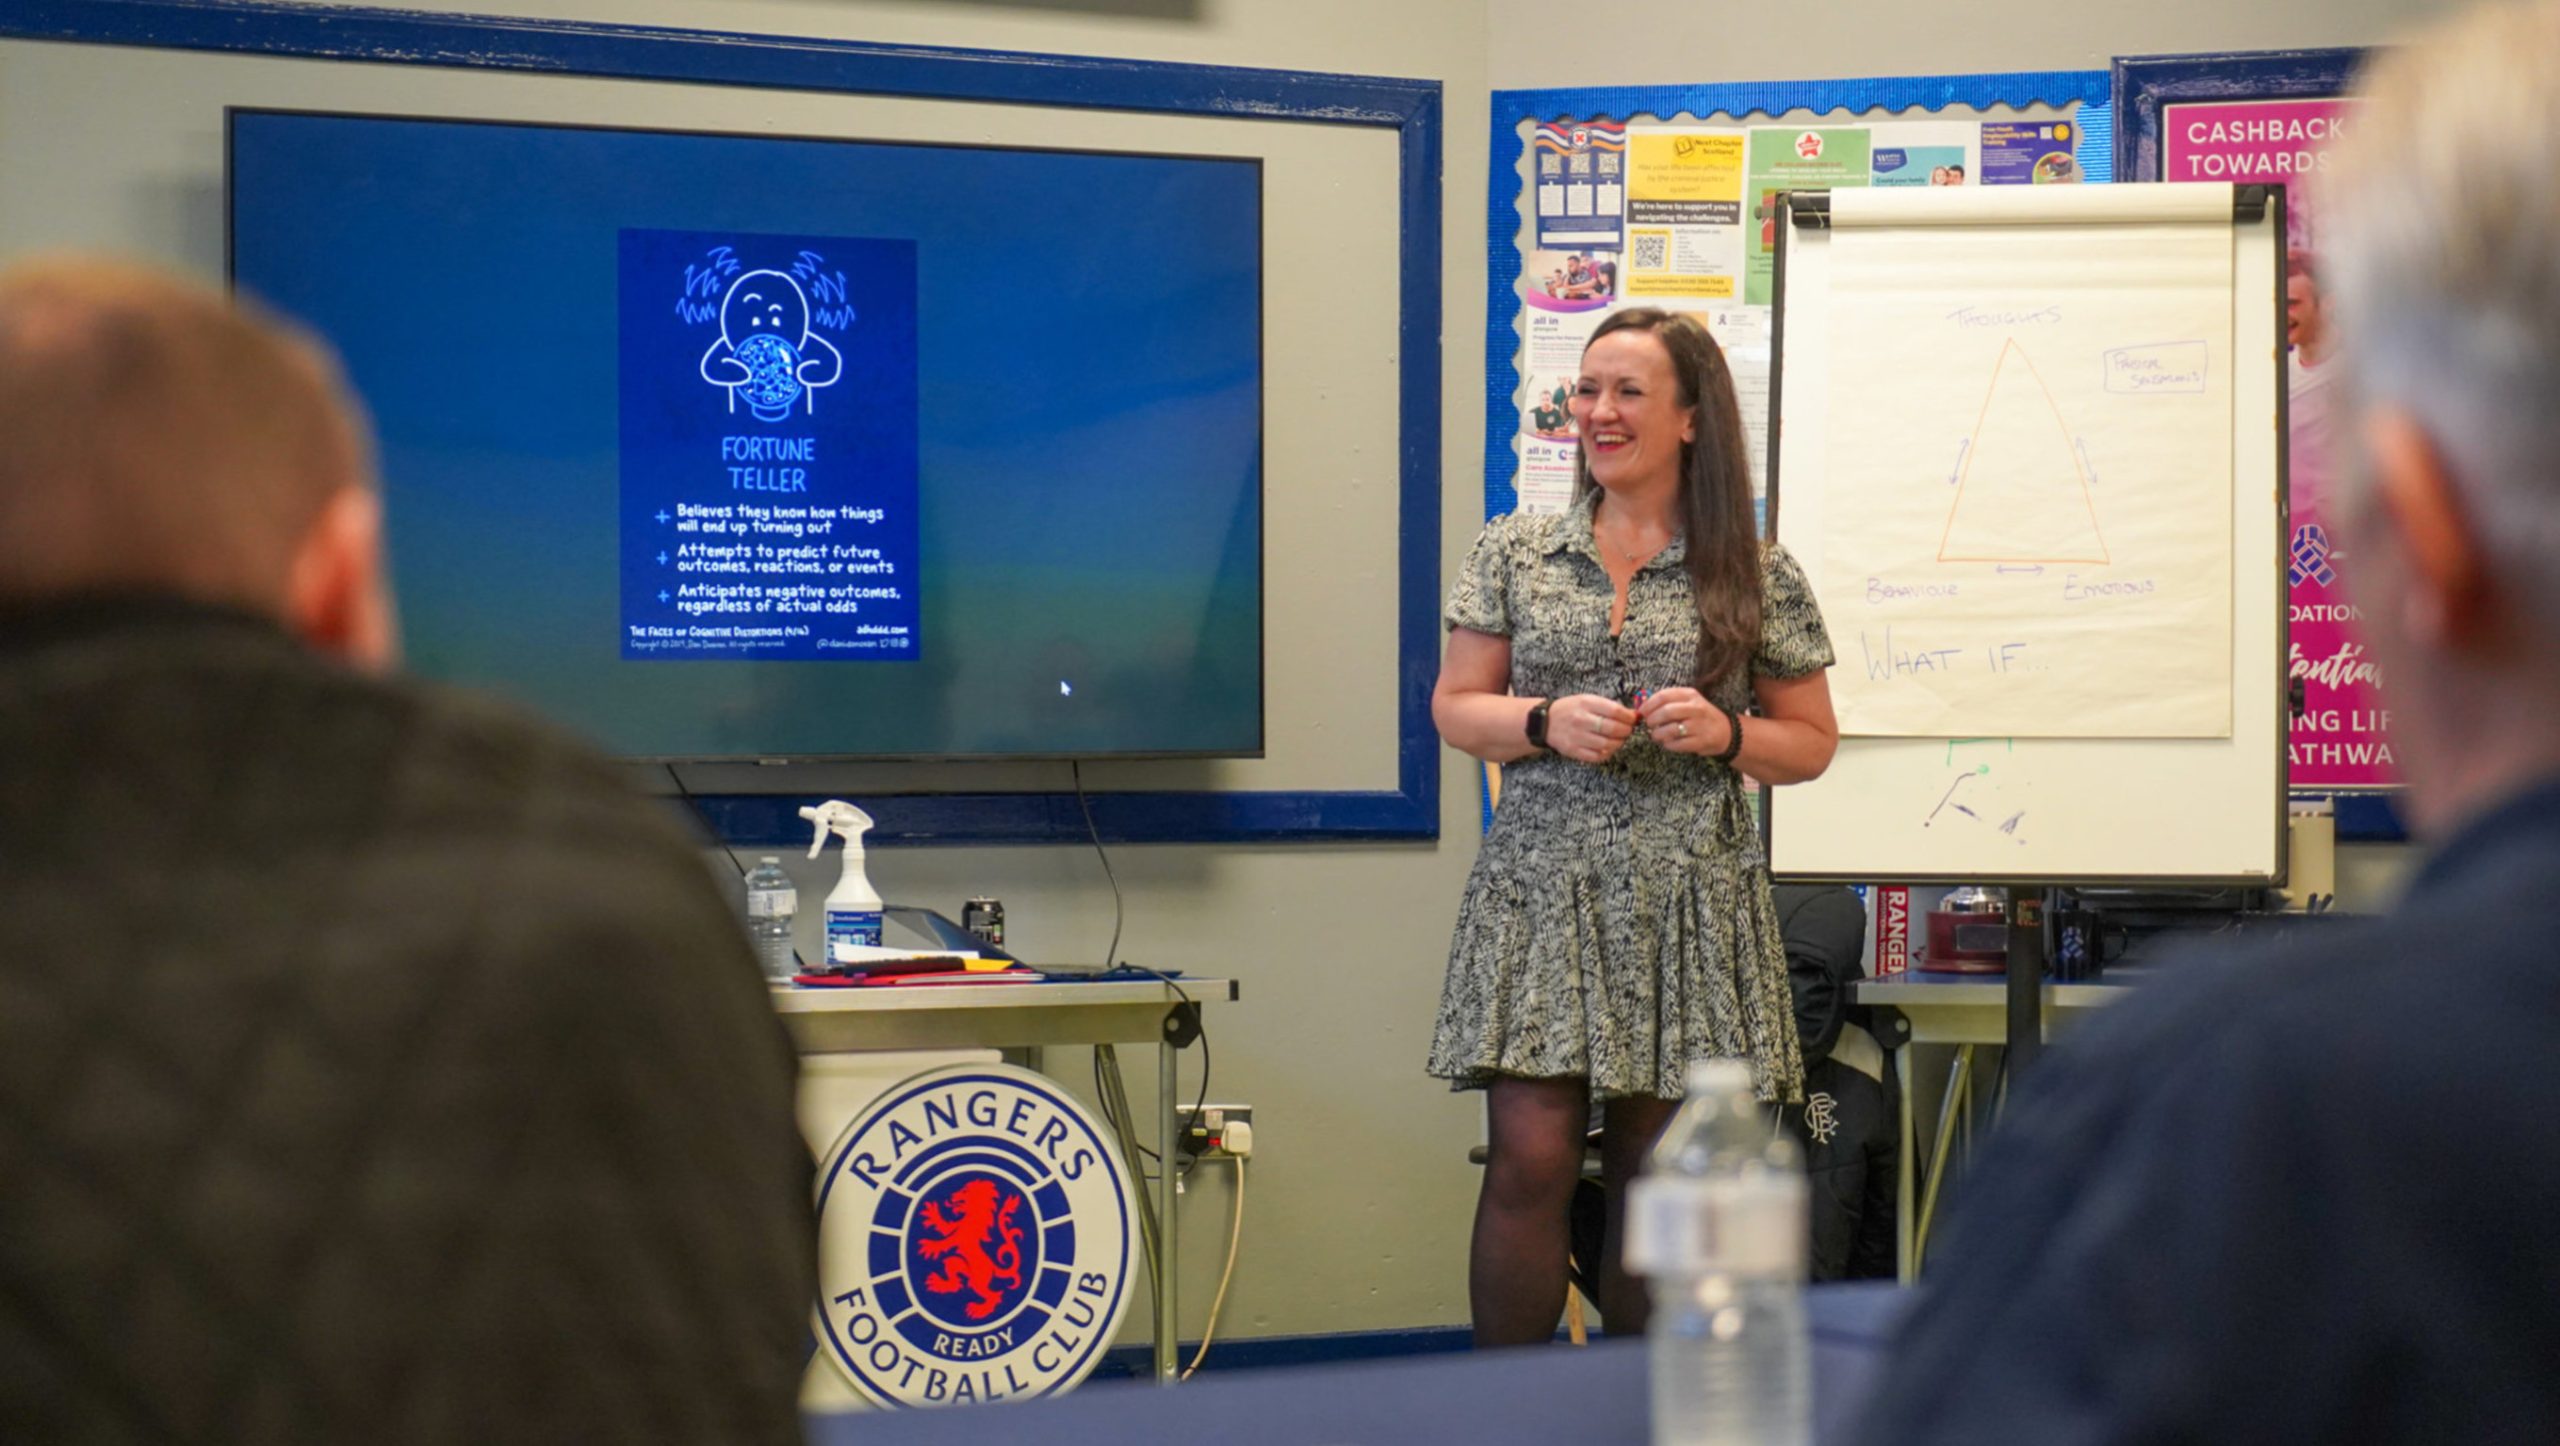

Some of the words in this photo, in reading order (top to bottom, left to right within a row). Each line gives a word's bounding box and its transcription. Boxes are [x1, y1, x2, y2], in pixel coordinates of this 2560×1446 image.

[2187, 117, 2344, 144] CASHBACK
[2187, 151, 2331, 176] TOWARDS
[1684, 203, 1713, 211] support
[1714, 204, 1728, 212] you
[1635, 214, 1675, 222] navigating
[1533, 317, 1546, 325] all
[1548, 317, 1559, 325] in
[722, 437, 815, 461] FORTUNE
[1526, 447, 1539, 455] all
[1542, 447, 1552, 455] in
[728, 467, 806, 492] TELLER
[677, 503, 732, 518] Believes
[737, 504, 770, 521] they
[773, 506, 806, 519] know
[810, 506, 836, 519] how
[840, 506, 884, 524] things
[677, 520, 698, 533] will
[702, 521, 725, 533] end
[730, 522, 747, 535] up
[752, 521, 803, 537] turning
[807, 522, 832, 534] out
[677, 543, 751, 560] Attempts
[756, 545, 774, 557] to
[777, 545, 828, 560] predict
[833, 545, 880, 559] future
[677, 558, 751, 573] outcomes,
[754, 559, 824, 574] reactions,
[828, 561, 842, 573] or
[847, 560, 894, 574] events
[677, 583, 761, 600] Anticipates
[766, 584, 826, 600] negative
[829, 585, 901, 600] outcomes,
[677, 600, 751, 615] regardless
[756, 599, 771, 613] of
[776, 600, 822, 613] actual
[825, 600, 857, 613] odds
[1861, 624, 1962, 681] WHAT
[848, 1090, 1095, 1190] RANGERS
[834, 1287, 1029, 1404] FOOTBALL
[1033, 1271, 1107, 1373] CLUB
[933, 1326, 1015, 1357] READY
